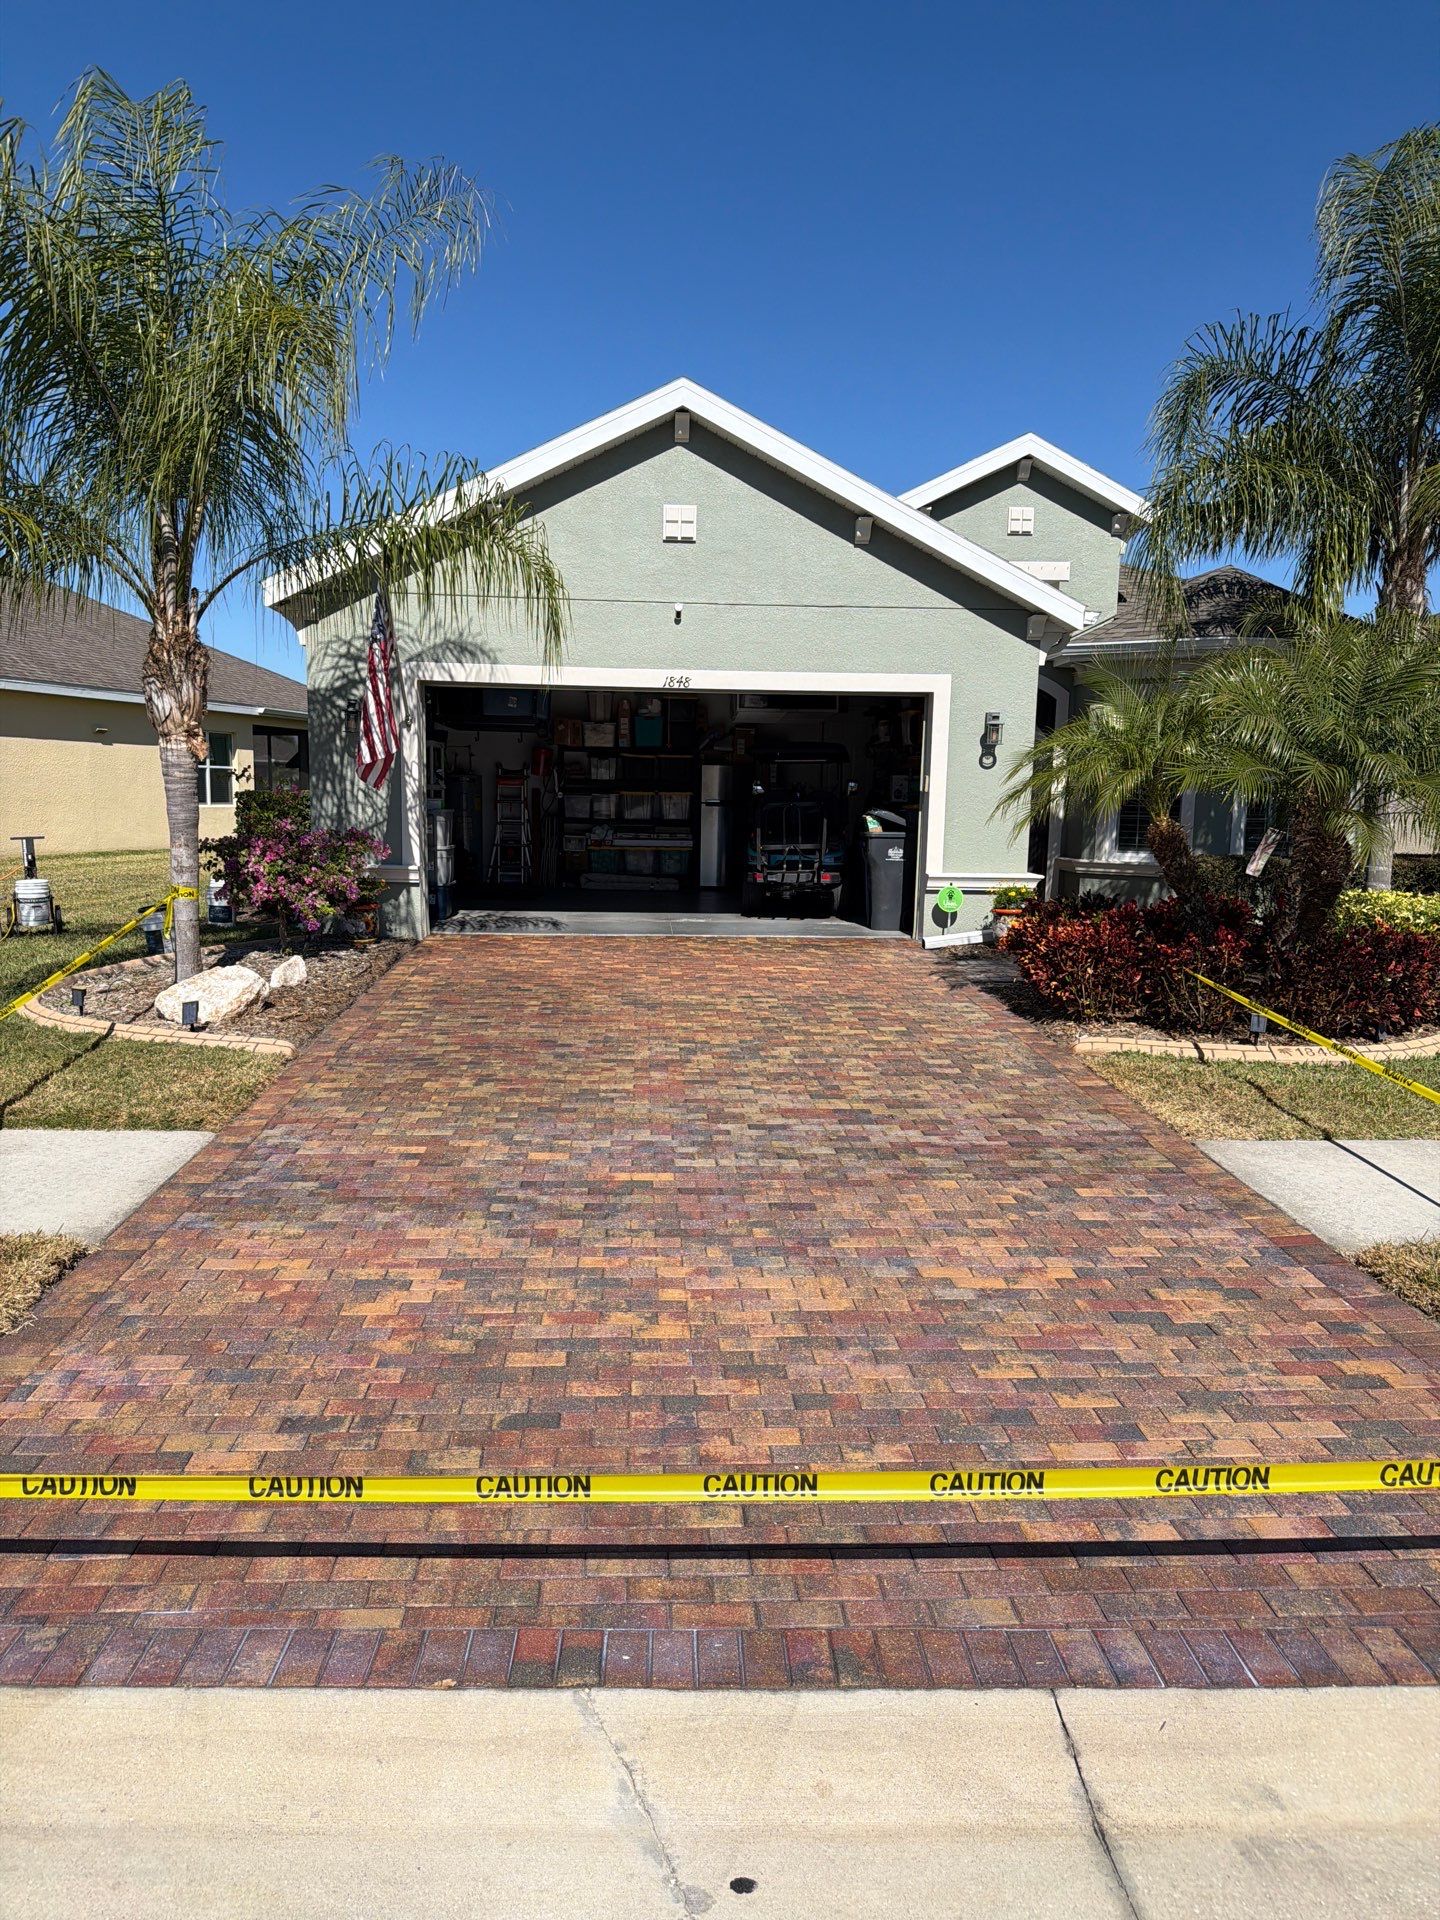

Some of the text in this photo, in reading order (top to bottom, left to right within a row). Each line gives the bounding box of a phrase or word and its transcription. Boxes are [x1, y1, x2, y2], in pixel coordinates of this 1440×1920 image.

[663, 675, 692, 688] 1848
[22, 1477, 137, 1496] CAUTION
[249, 1476, 364, 1498] CAUTION
[476, 1475, 591, 1499] CAUTION
[703, 1474, 818, 1498] CAUTION
[929, 1471, 1045, 1496] CAUTION
[1156, 1467, 1270, 1492] CAUTION
